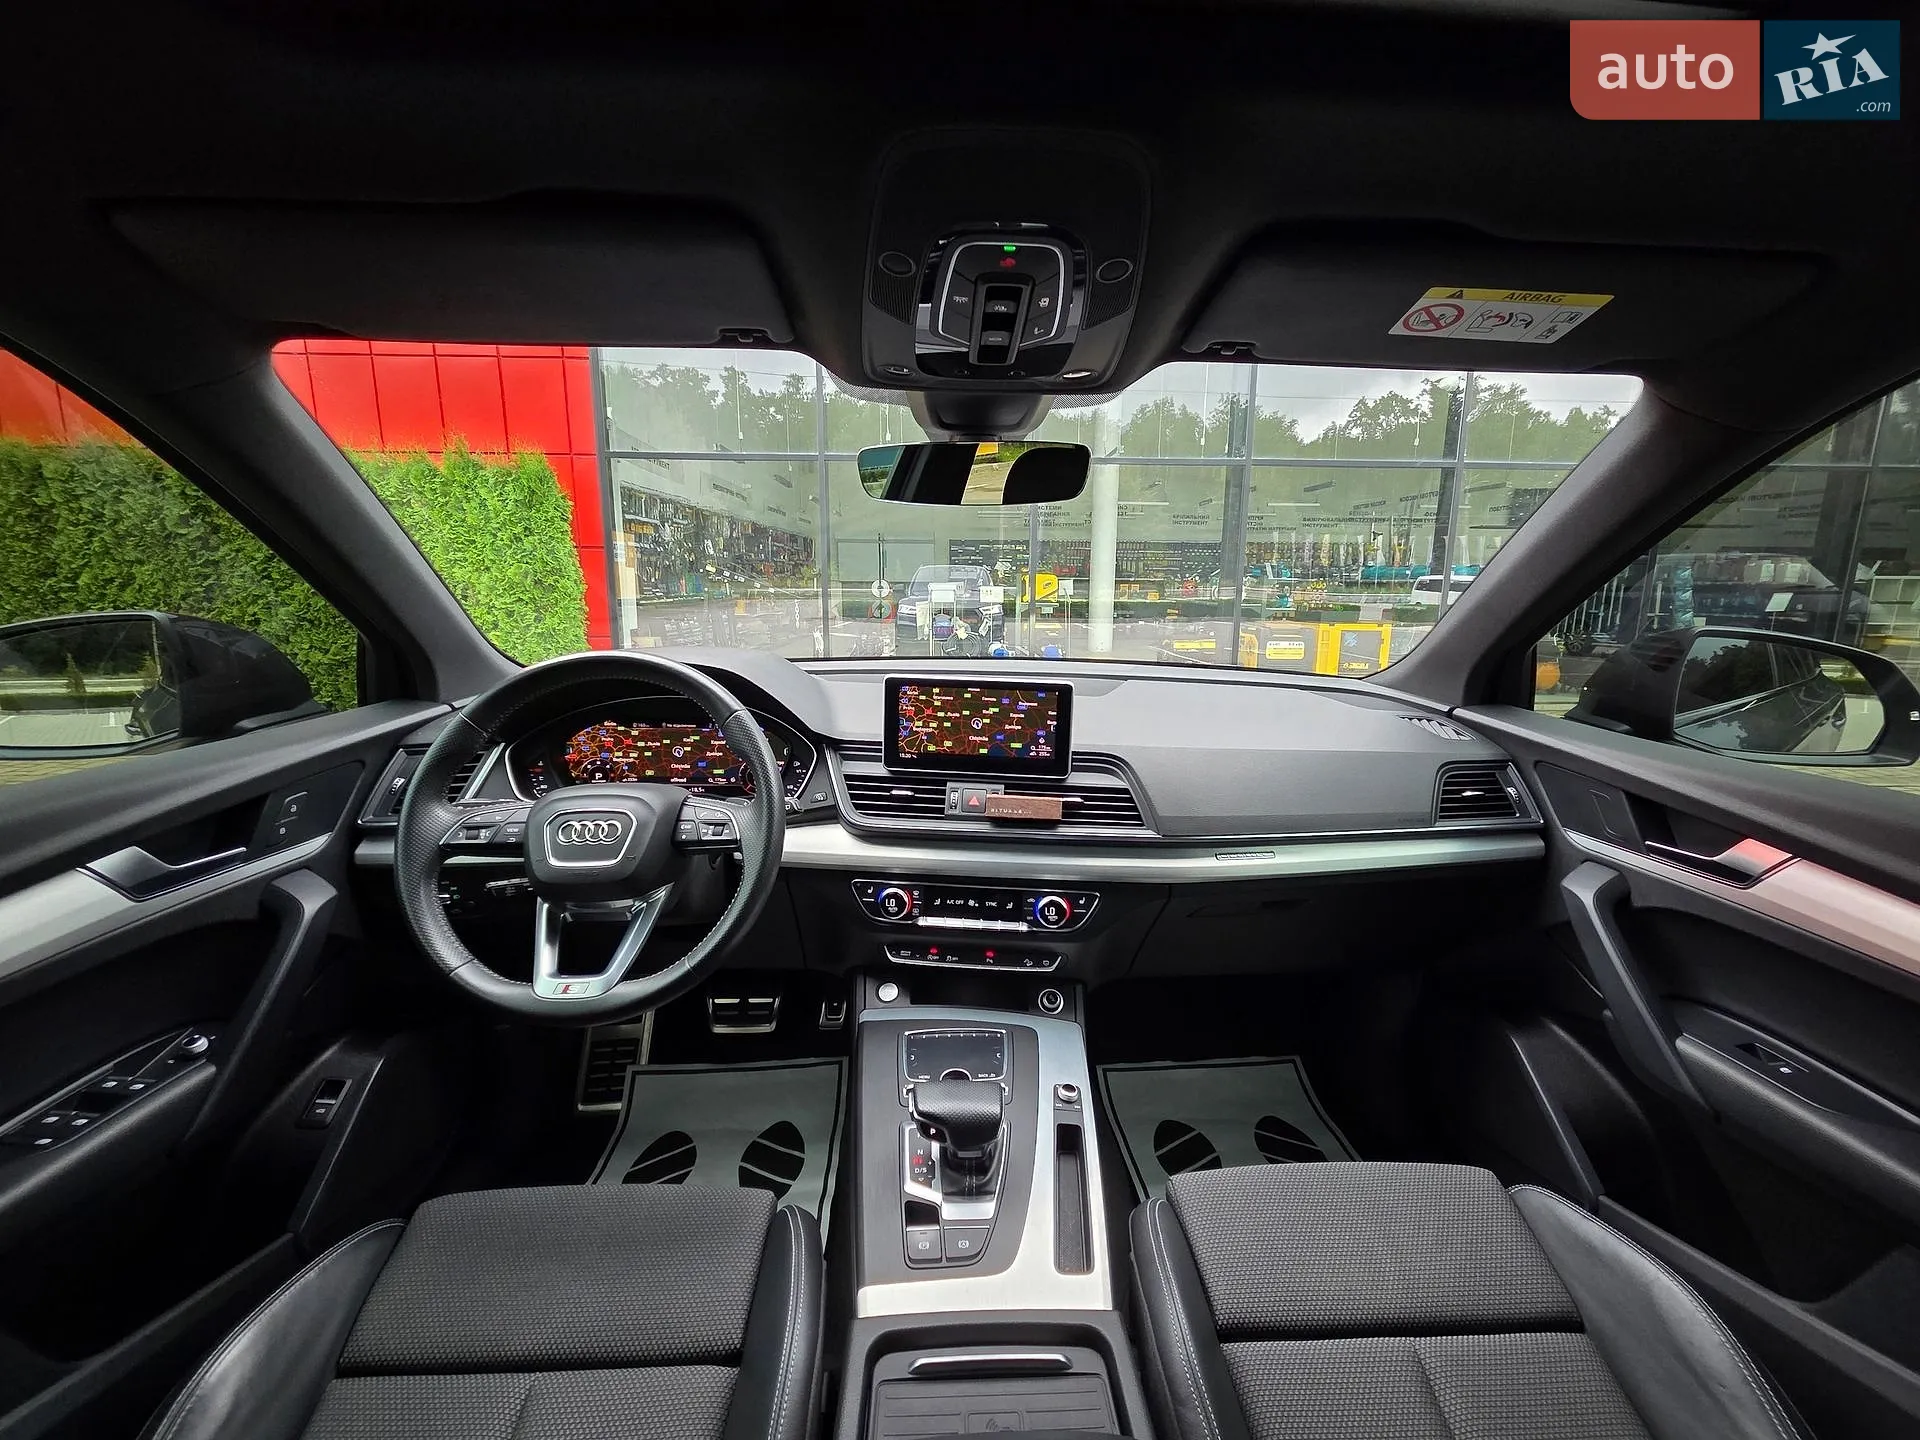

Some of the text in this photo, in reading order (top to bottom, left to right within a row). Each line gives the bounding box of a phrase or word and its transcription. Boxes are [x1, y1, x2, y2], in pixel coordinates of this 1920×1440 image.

[1503, 292, 1567, 304] AIRBAG
[885, 898, 896, 907] LO
[1045, 906, 1056, 916] LO
[930, 1127, 936, 1136] P
[917, 1148, 924, 1156] N
